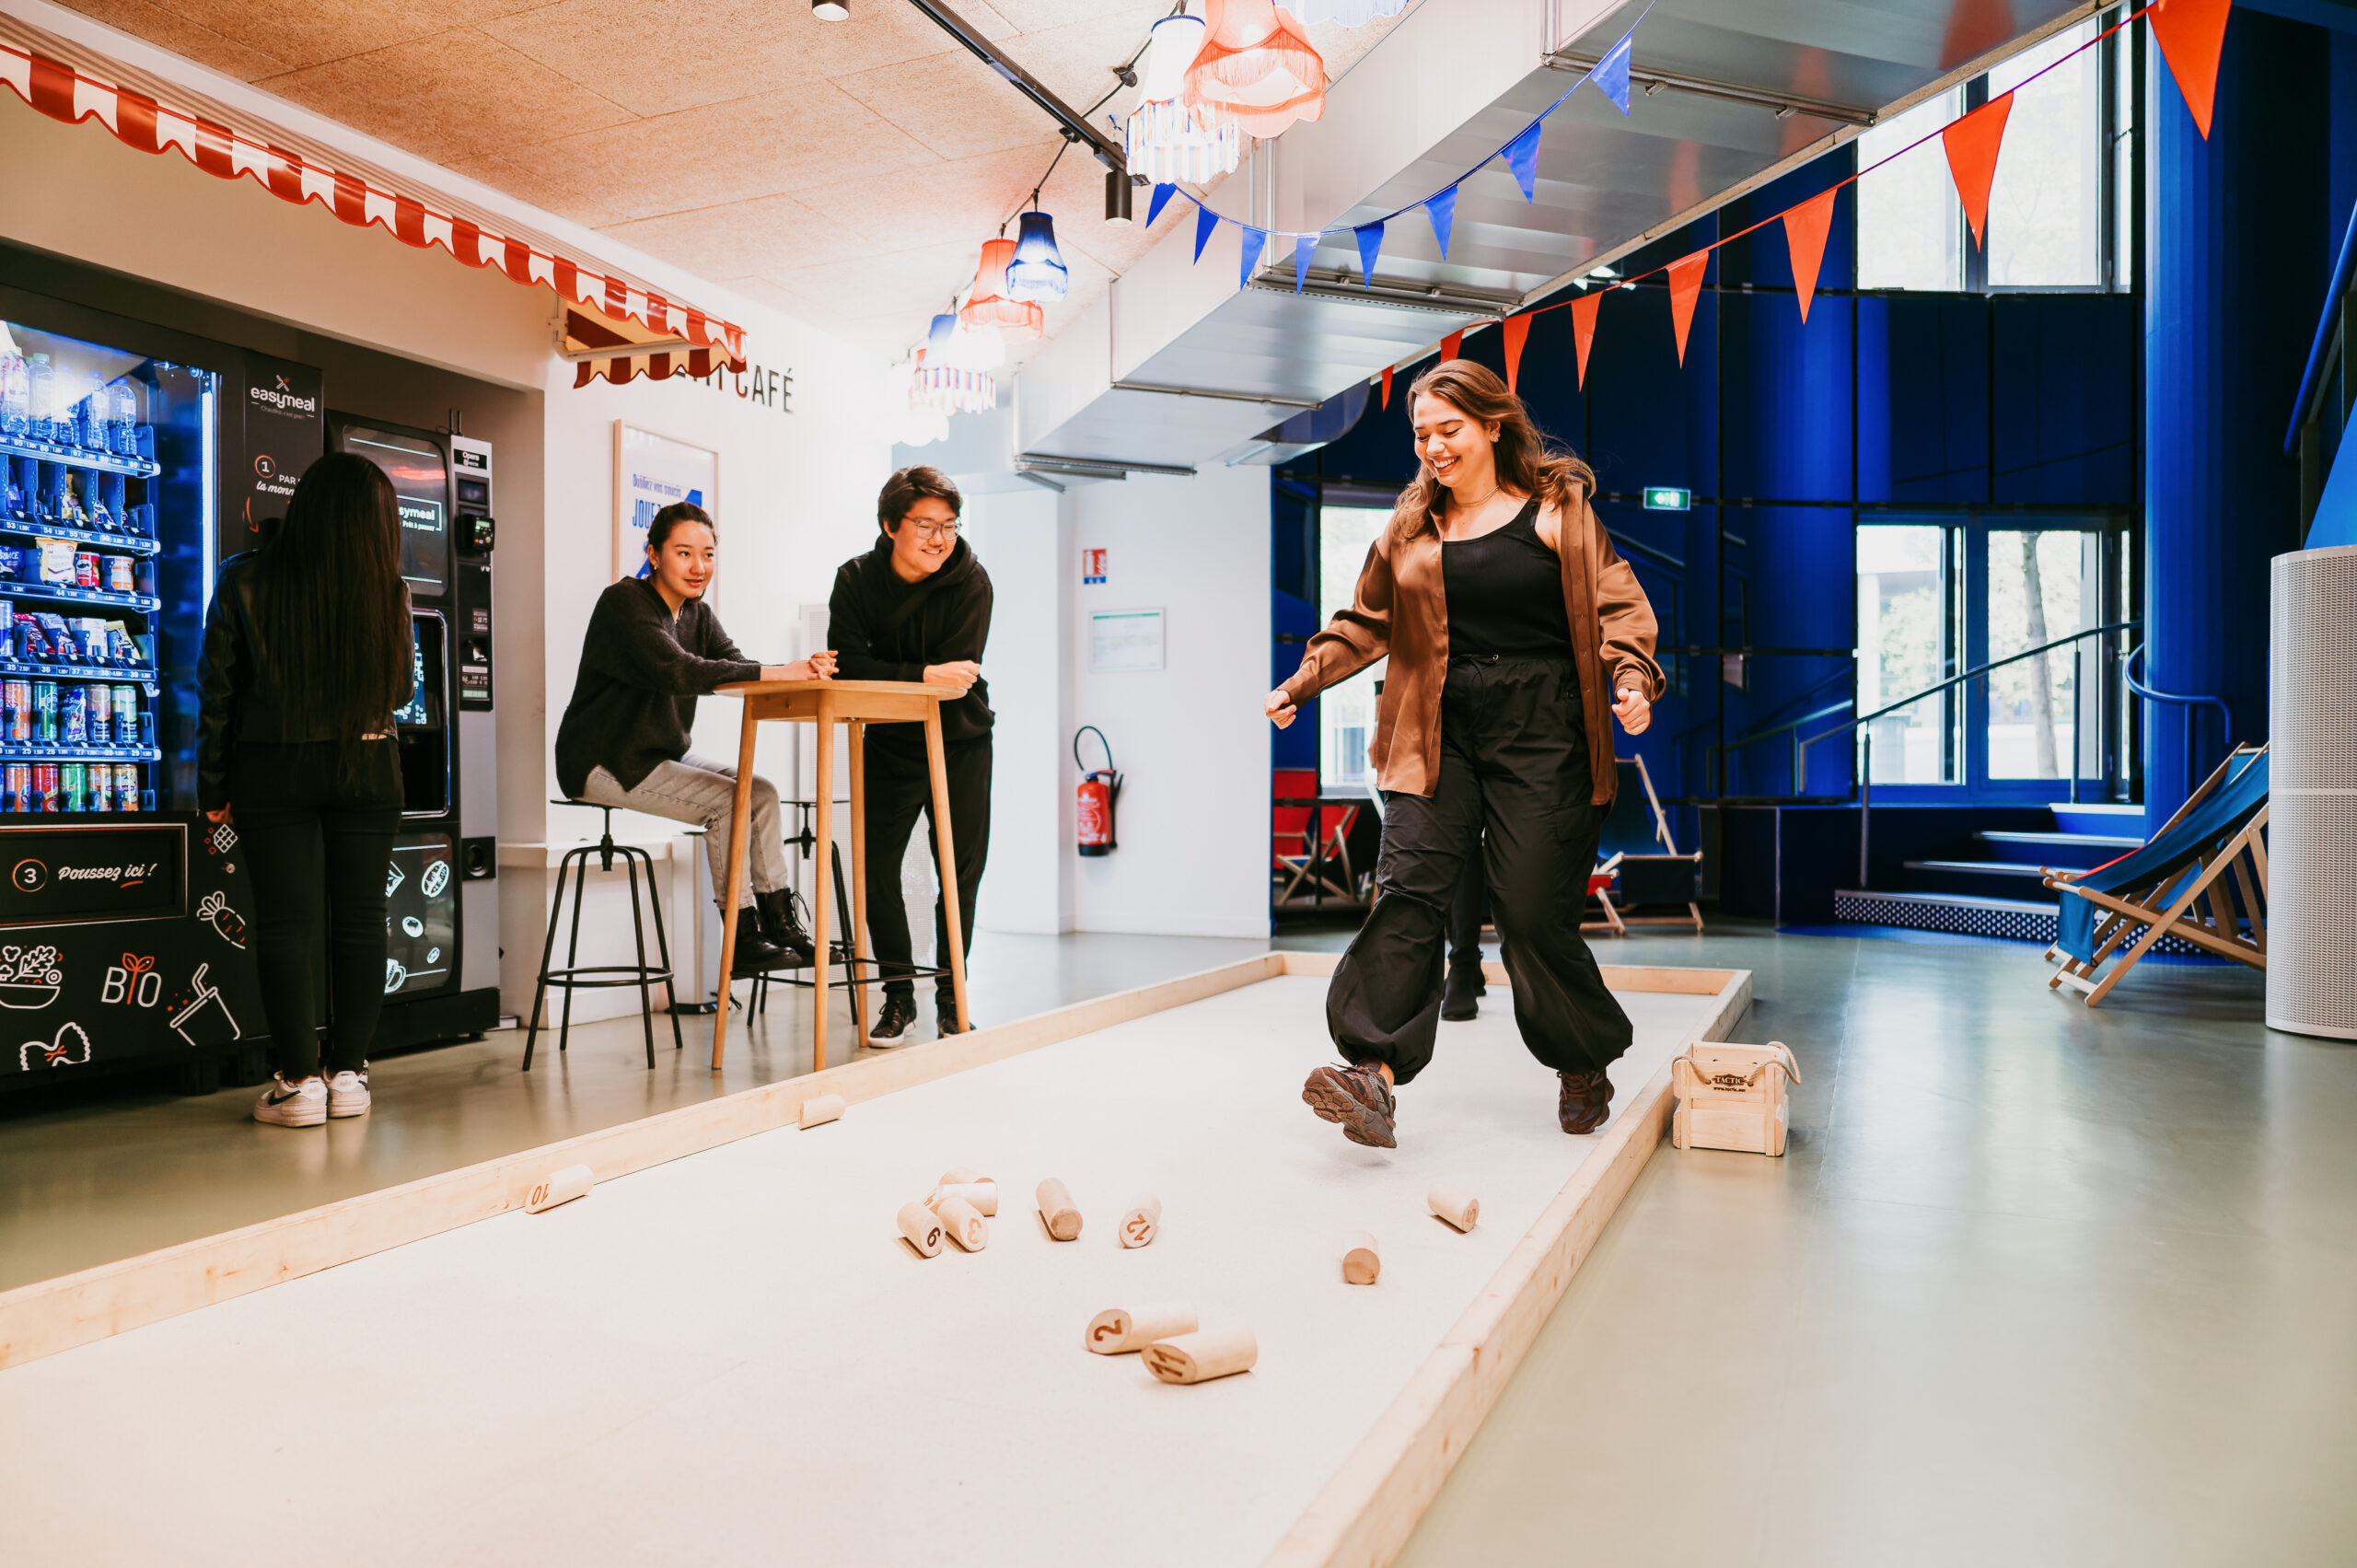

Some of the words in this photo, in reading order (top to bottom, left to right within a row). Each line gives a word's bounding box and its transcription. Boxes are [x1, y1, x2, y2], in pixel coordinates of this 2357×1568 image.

[736, 365, 794, 414] CAFÉ
[250, 387, 315, 412] easymeal
[261, 461, 270, 473] 1
[256, 480, 267, 492] la
[268, 484, 295, 496] monn
[279, 474, 296, 485] PAR
[399, 506, 435, 521] symeal
[632, 498, 661, 529] JOUE
[24, 868, 37, 884] 3
[58, 866, 122, 881] Poussez
[124, 864, 145, 877] ici
[100, 952, 162, 1008] BIO
[1715, 1076, 1743, 1085] TACTIC
[1093, 1318, 1123, 1342] 2
[1150, 1348, 1187, 1377] 11
